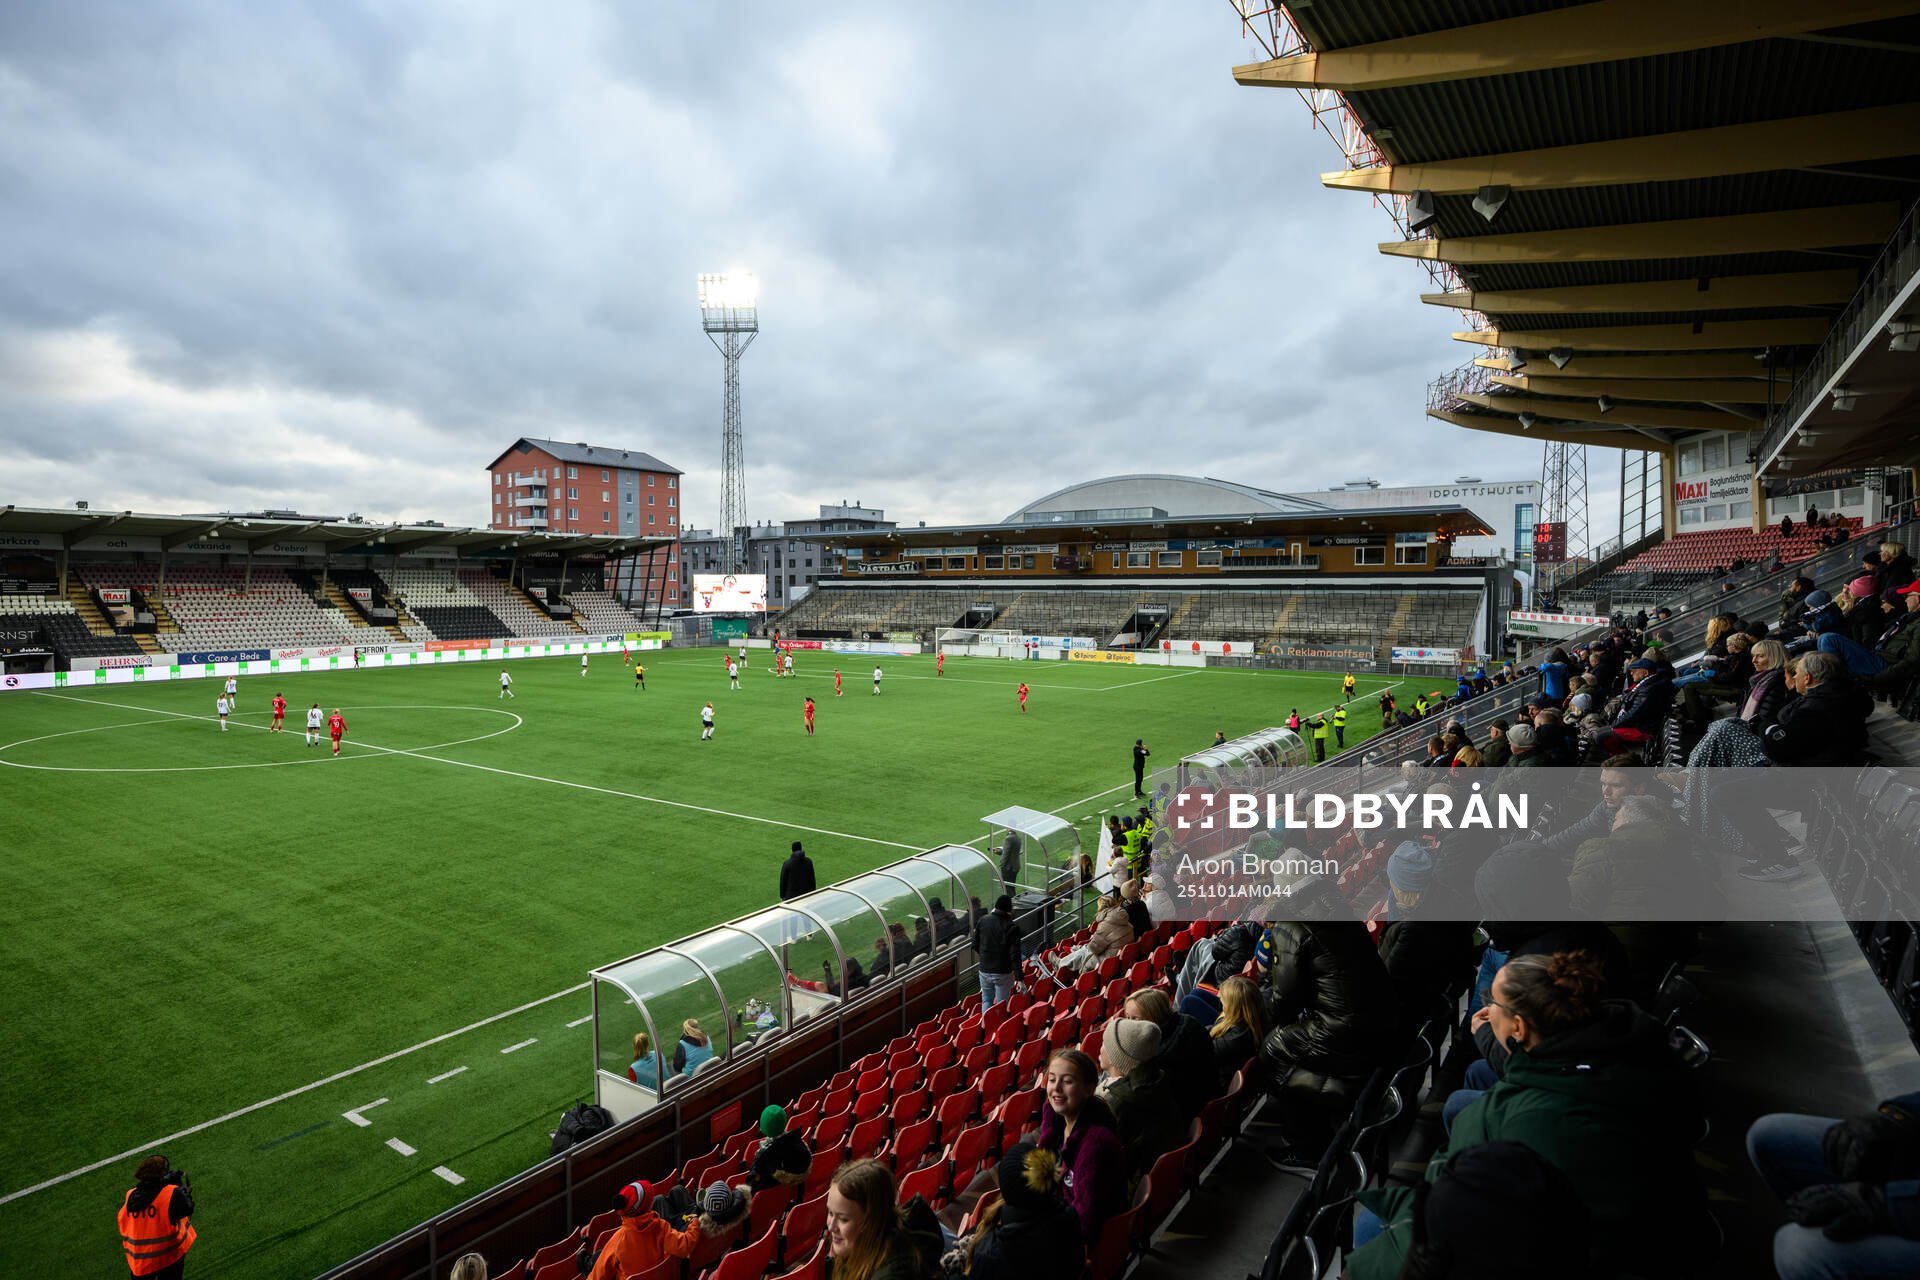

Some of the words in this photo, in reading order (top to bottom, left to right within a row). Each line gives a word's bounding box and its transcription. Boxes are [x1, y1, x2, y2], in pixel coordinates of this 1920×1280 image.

[1429, 485, 1534, 498] IDROTTSHUSET
[1675, 481, 1708, 500] MAXI
[106, 539, 128, 548] och
[366, 645, 389, 654] FRONT
[1287, 647, 1371, 659] Reklamproffsen
[99, 658, 139, 666] BEHRN
[207, 654, 229, 663] Care
[240, 652, 260, 661] Beds
[1112, 653, 1131, 661] Epiroc
